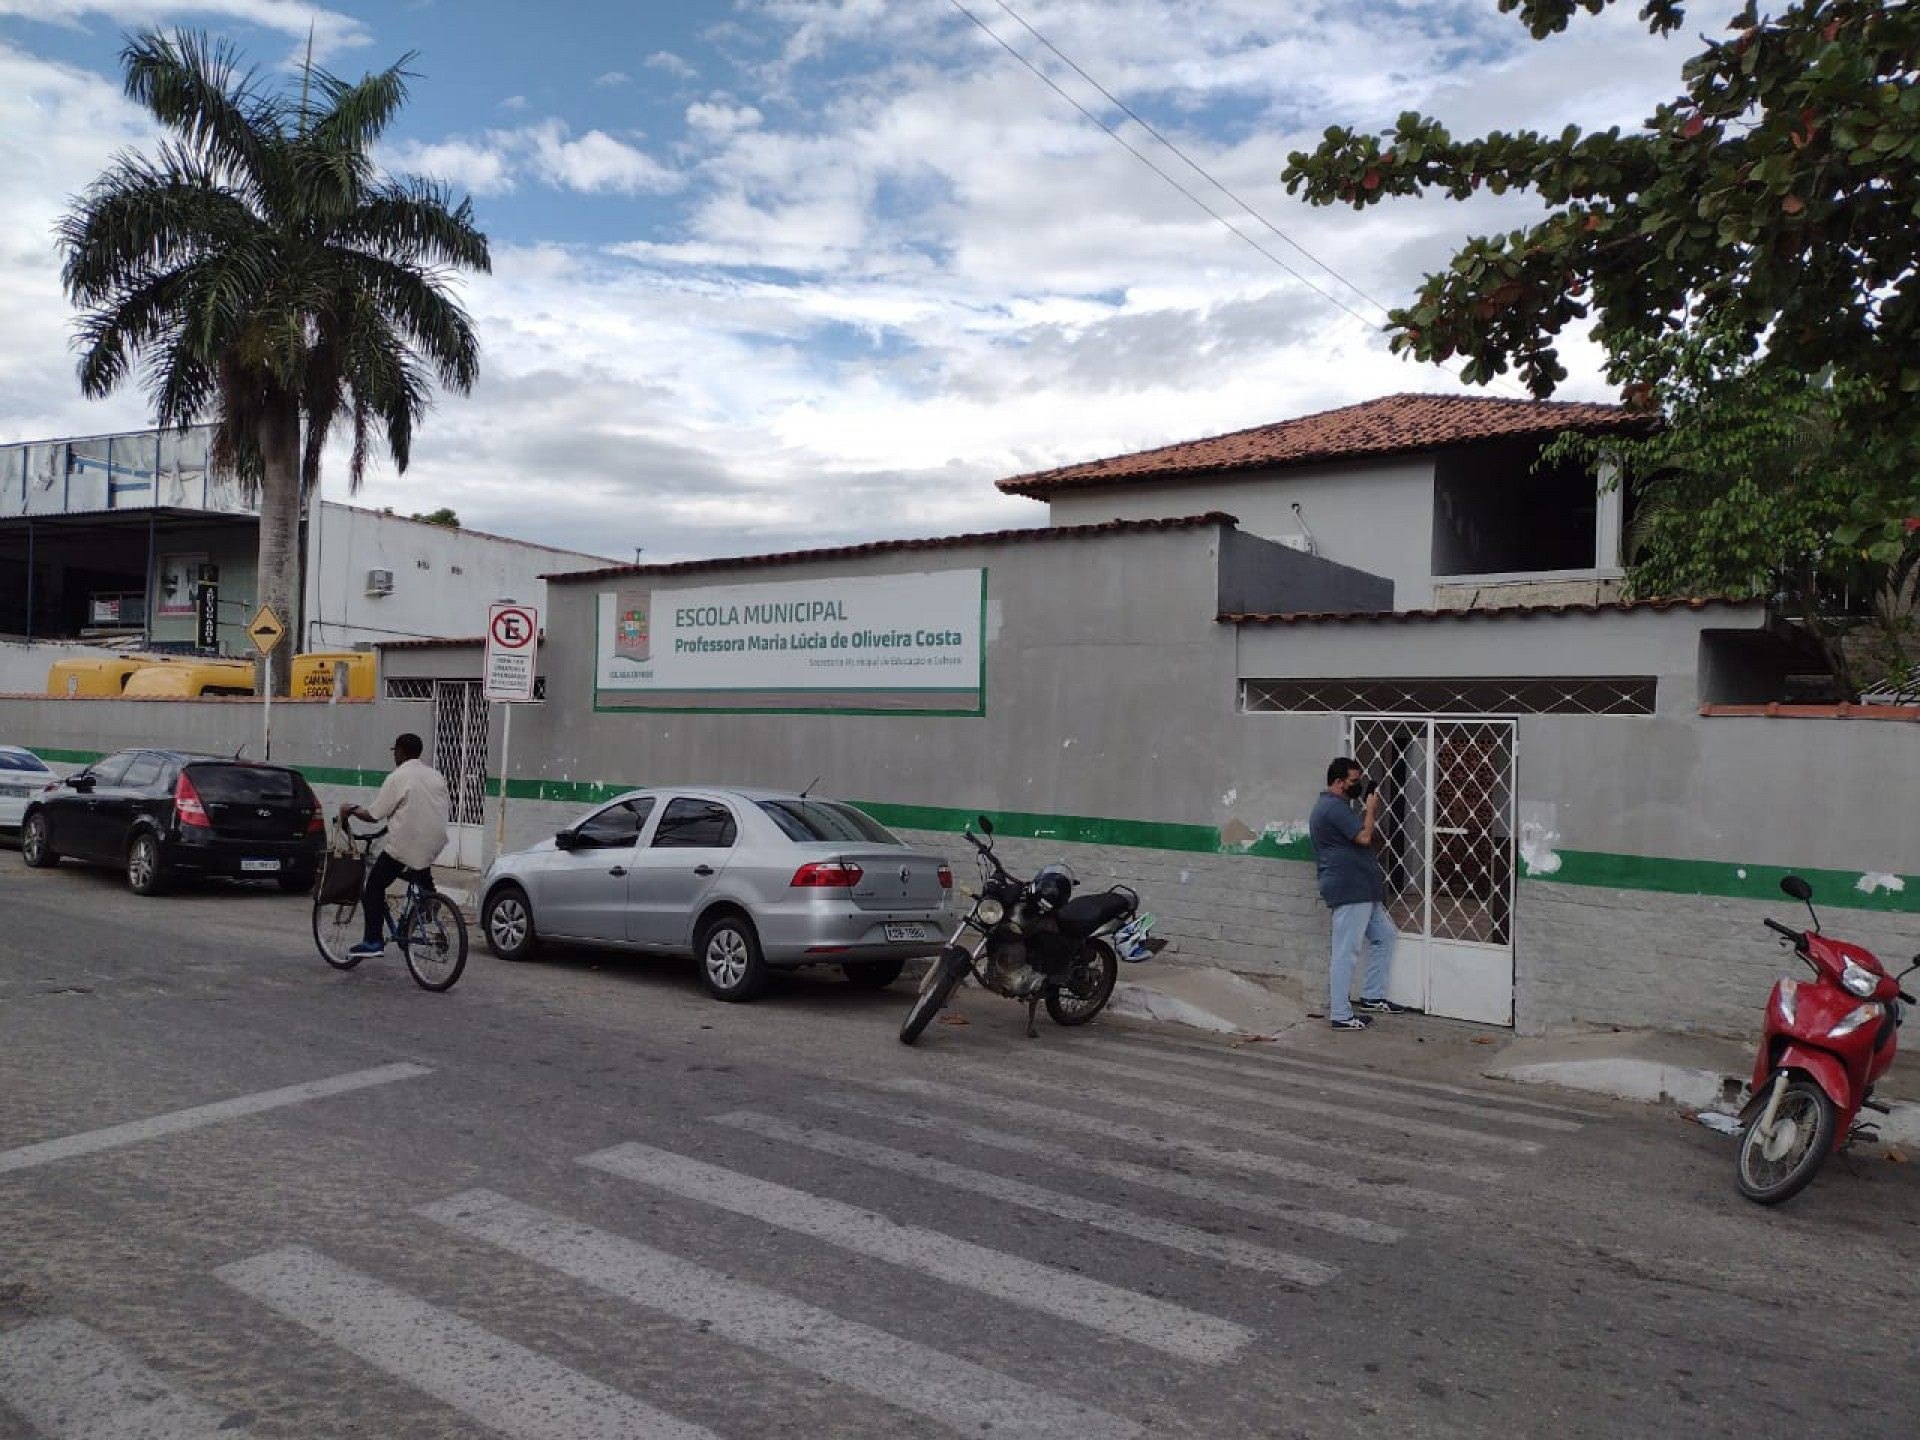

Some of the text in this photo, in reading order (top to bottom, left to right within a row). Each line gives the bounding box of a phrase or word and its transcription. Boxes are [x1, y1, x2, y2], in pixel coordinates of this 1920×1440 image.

[675, 600, 848, 628] ESCOLA MUNICIPAL
[675, 629, 962, 653] Professora Maria Lúcia de Oliveira Costa
